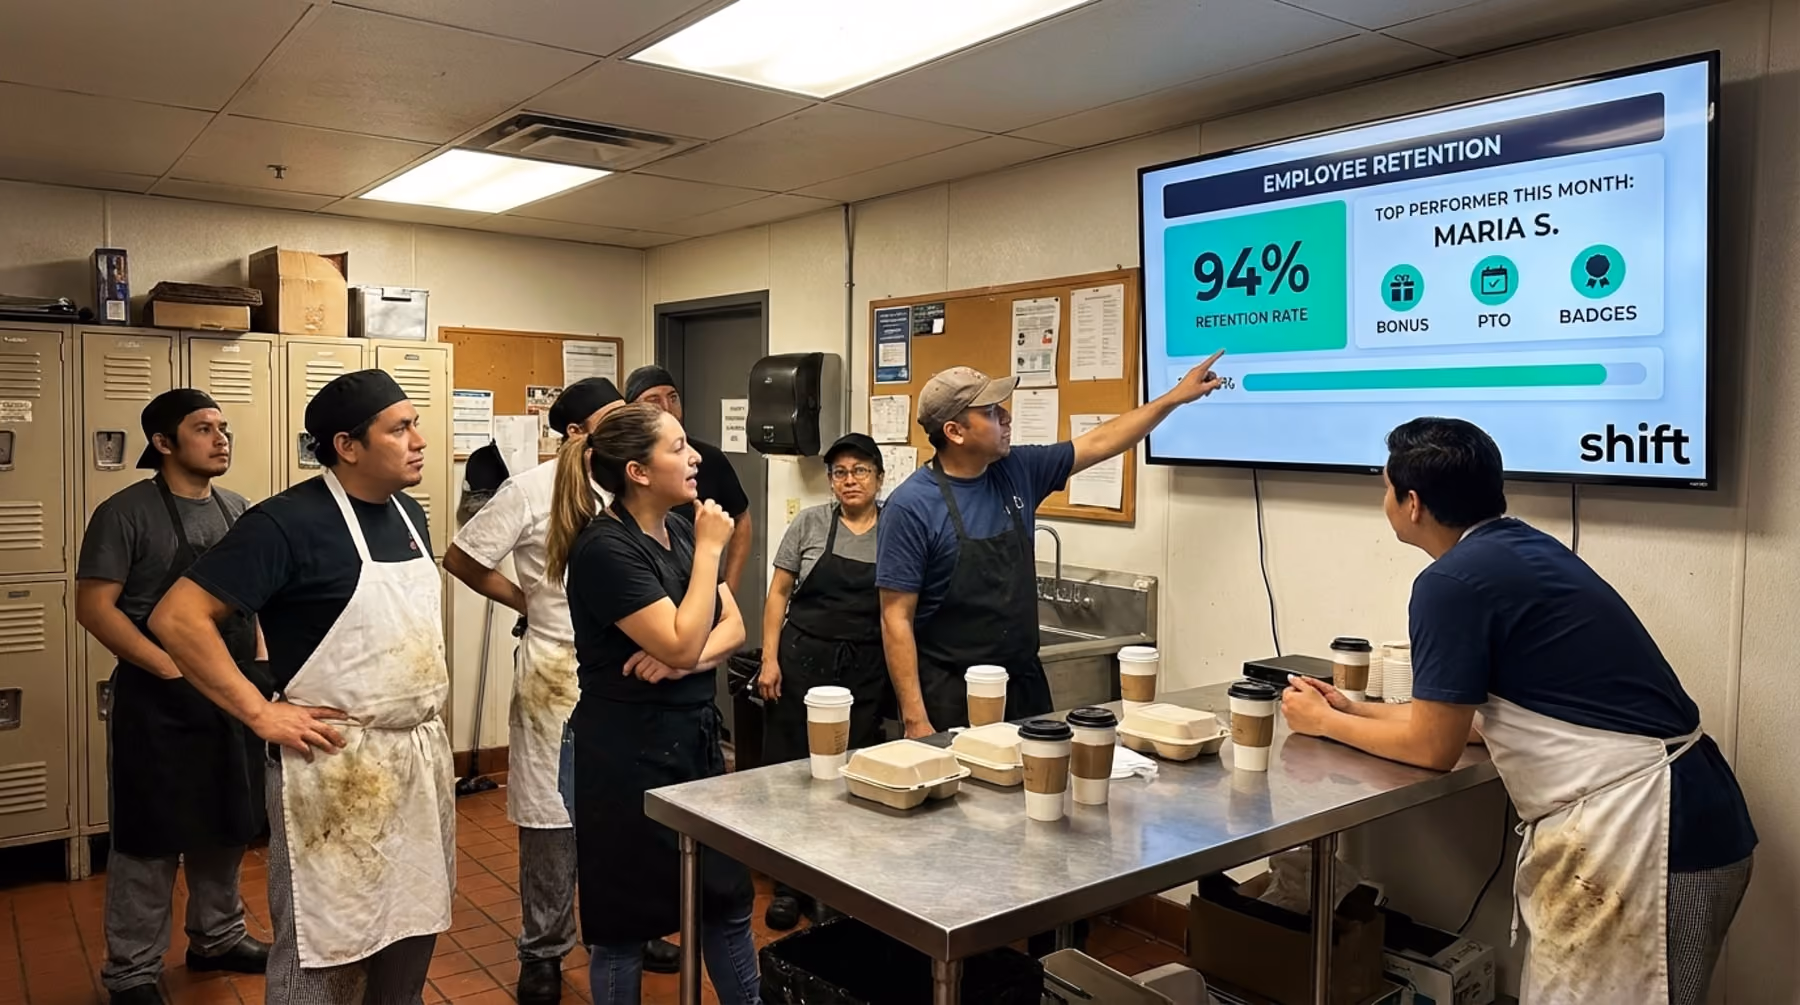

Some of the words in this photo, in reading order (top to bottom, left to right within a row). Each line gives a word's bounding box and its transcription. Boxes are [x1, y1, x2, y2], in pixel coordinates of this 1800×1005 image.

[1263, 158, 1367, 193] EMPLOYEE
[1373, 134, 1502, 176] RETENTION
[1375, 206, 1405, 222] TOP
[1409, 191, 1509, 218] PERFORMER
[1514, 184, 1553, 203] THIS
[1558, 174, 1635, 199] MONTH:
[1434, 216, 1526, 248] MARIA
[1534, 212, 1560, 237] S.
[1193, 240, 1310, 302] 94%
[1195, 311, 1268, 329] RETENTION
[1272, 308, 1309, 324] RATE
[1376, 318, 1430, 334] BONUS
[1478, 313, 1512, 329] PTO
[1559, 305, 1638, 325] BADGES
[1580, 422, 1691, 466] shift
